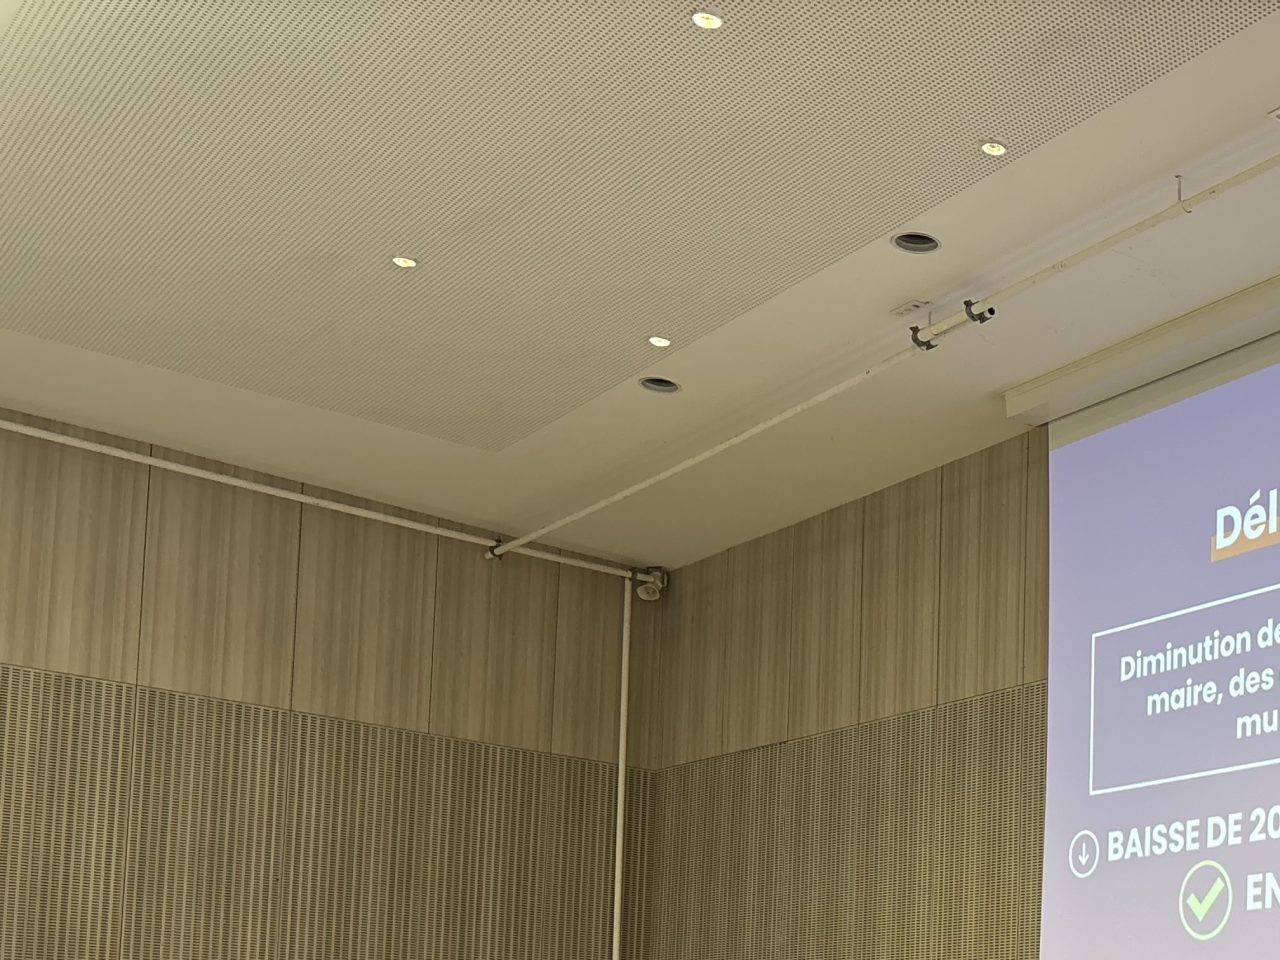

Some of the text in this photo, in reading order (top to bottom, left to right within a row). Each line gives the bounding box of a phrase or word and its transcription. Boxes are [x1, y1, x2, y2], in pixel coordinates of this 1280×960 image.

[1120, 629, 1251, 682] Diminution
[1147, 677, 1223, 716] maire,
[1228, 667, 1274, 698] des
[1107, 818, 1201, 862] BAISSE
[1206, 811, 1243, 849] DE
